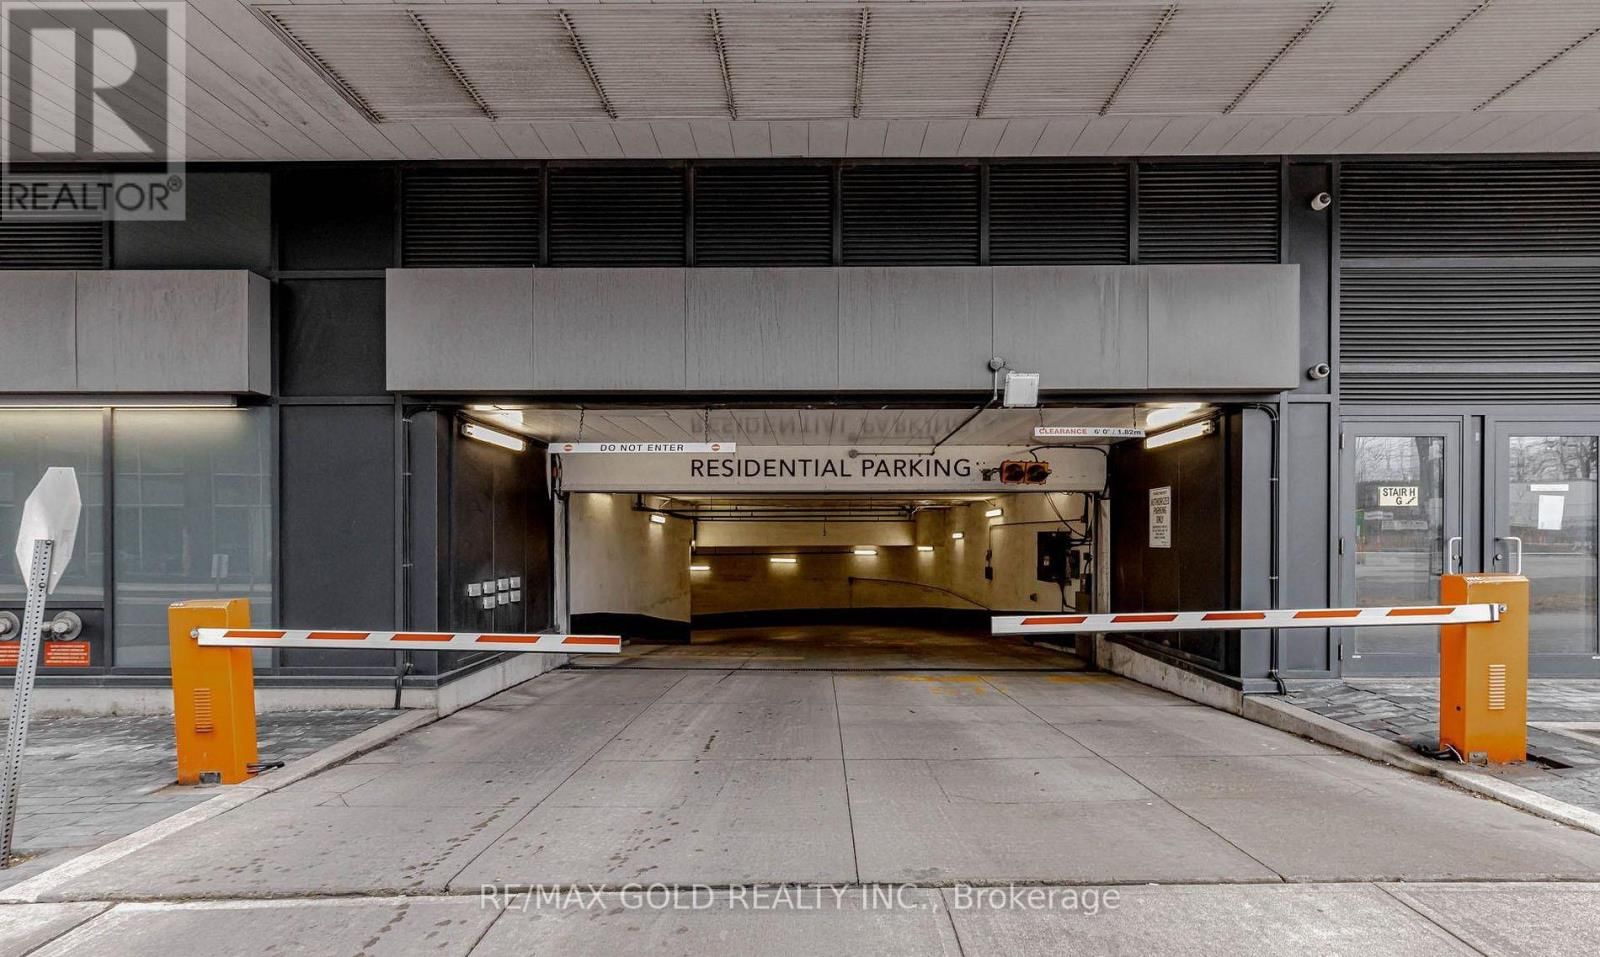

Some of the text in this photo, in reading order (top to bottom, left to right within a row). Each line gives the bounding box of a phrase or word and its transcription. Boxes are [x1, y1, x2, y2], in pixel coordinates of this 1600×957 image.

[600, 444, 684, 452] DO NOT ENTER
[691, 458, 971, 477] RESIDENTIAL PARKING
[1382, 487, 1416, 497] STAIR H
[1395, 496, 1403, 506] G
